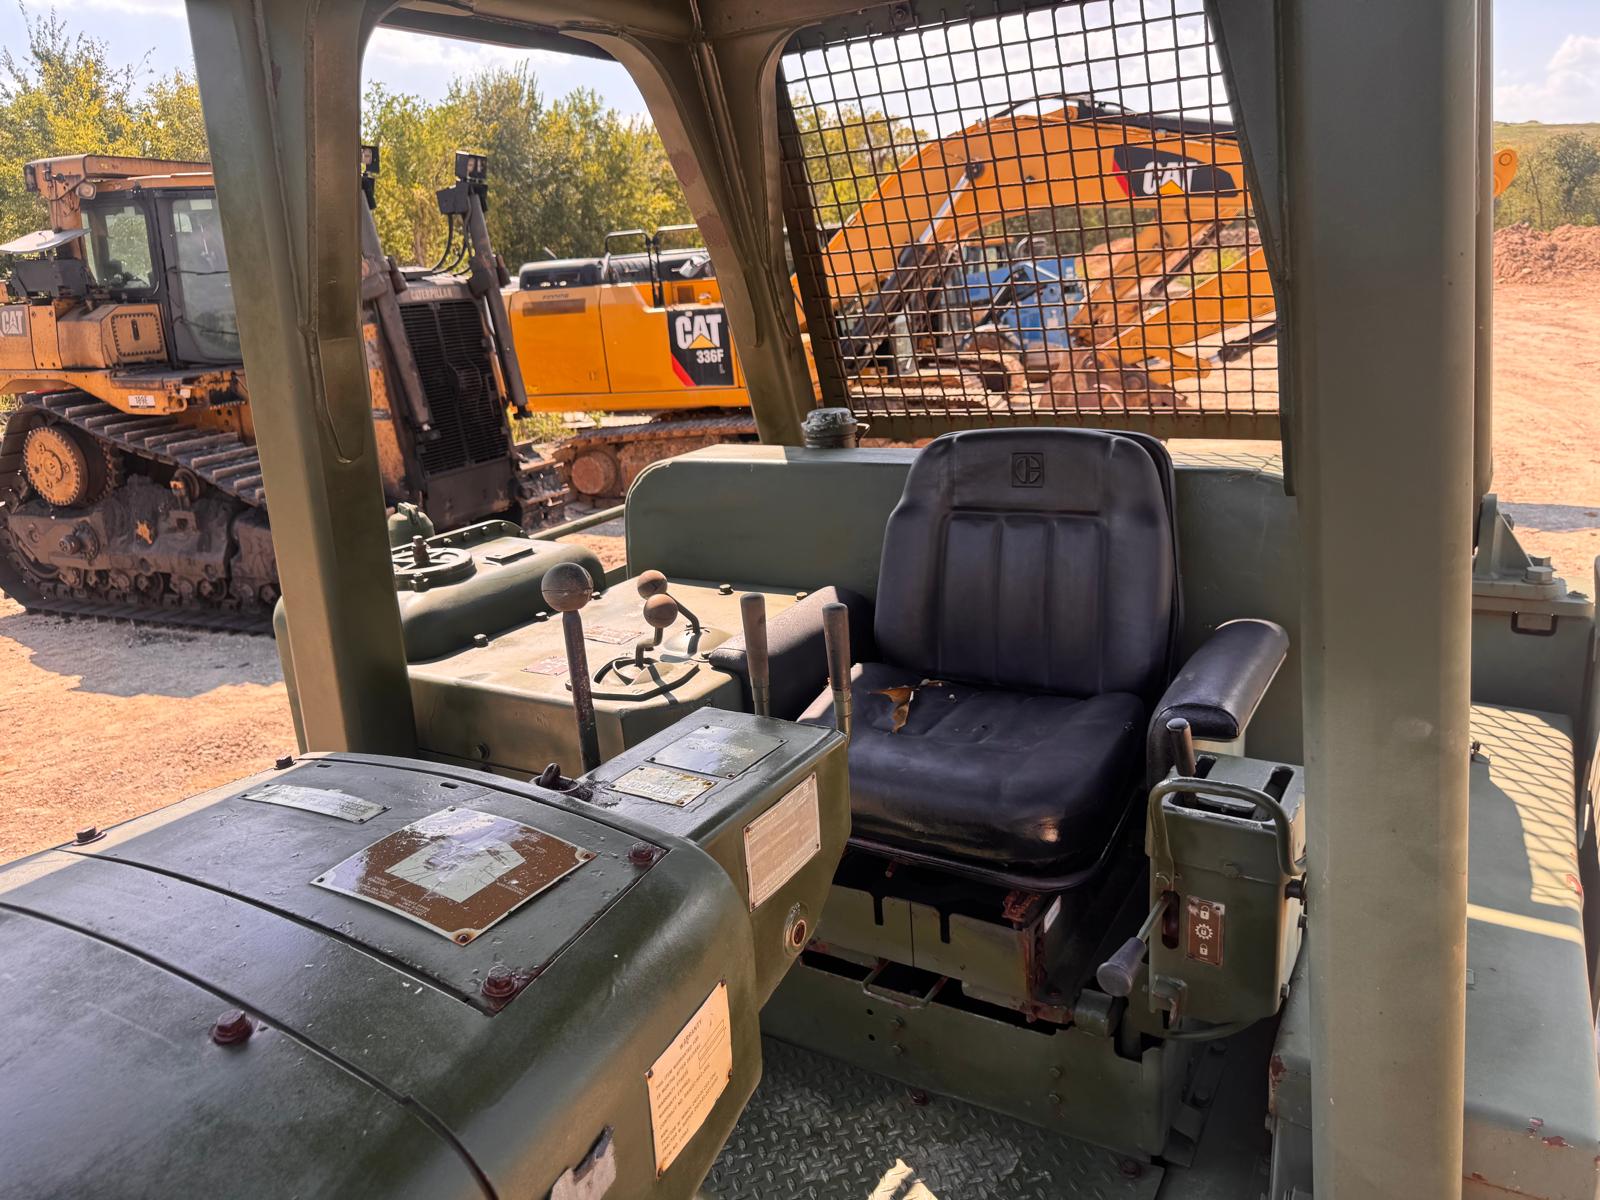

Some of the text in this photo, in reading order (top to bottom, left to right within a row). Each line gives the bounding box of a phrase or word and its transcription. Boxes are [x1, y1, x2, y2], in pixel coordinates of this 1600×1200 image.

[1143, 161, 1199, 194] CAT
[410, 287, 454, 300] CATERPILLAR
[1, 310, 23, 335] CAT
[675, 313, 722, 350] CAT
[696, 348, 724, 364] 336F
